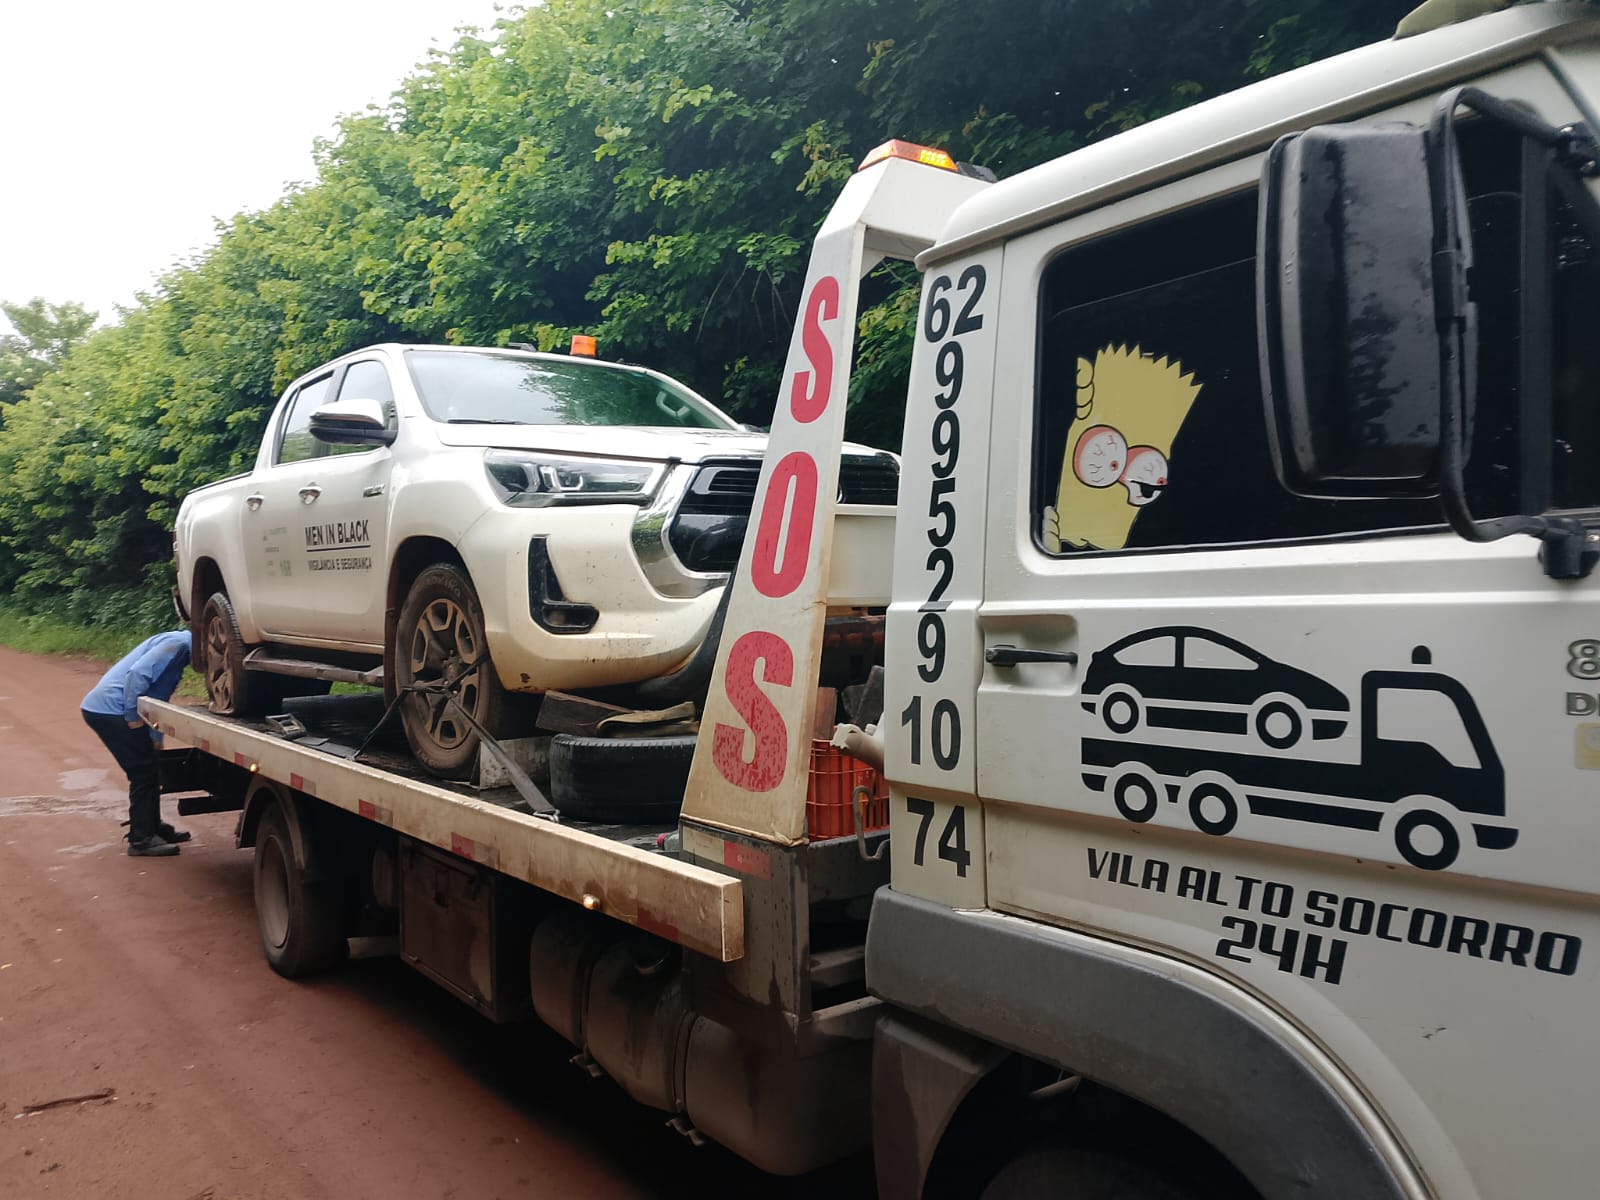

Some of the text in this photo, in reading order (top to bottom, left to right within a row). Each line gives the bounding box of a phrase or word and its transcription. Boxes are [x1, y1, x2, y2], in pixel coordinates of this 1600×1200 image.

[924, 264, 988, 343] 62
[305, 525, 323, 546] MEN
[325, 523, 335, 545] IN
[337, 519, 369, 543] BLACK
[336, 558, 341, 570] E
[902, 695, 962, 772] 10
[1566, 691, 1600, 717] D
[906, 797, 972, 878] 74
[1087, 847, 1582, 976] VILA ALTO SOCORRO
[1215, 915, 1349, 986] 24H
